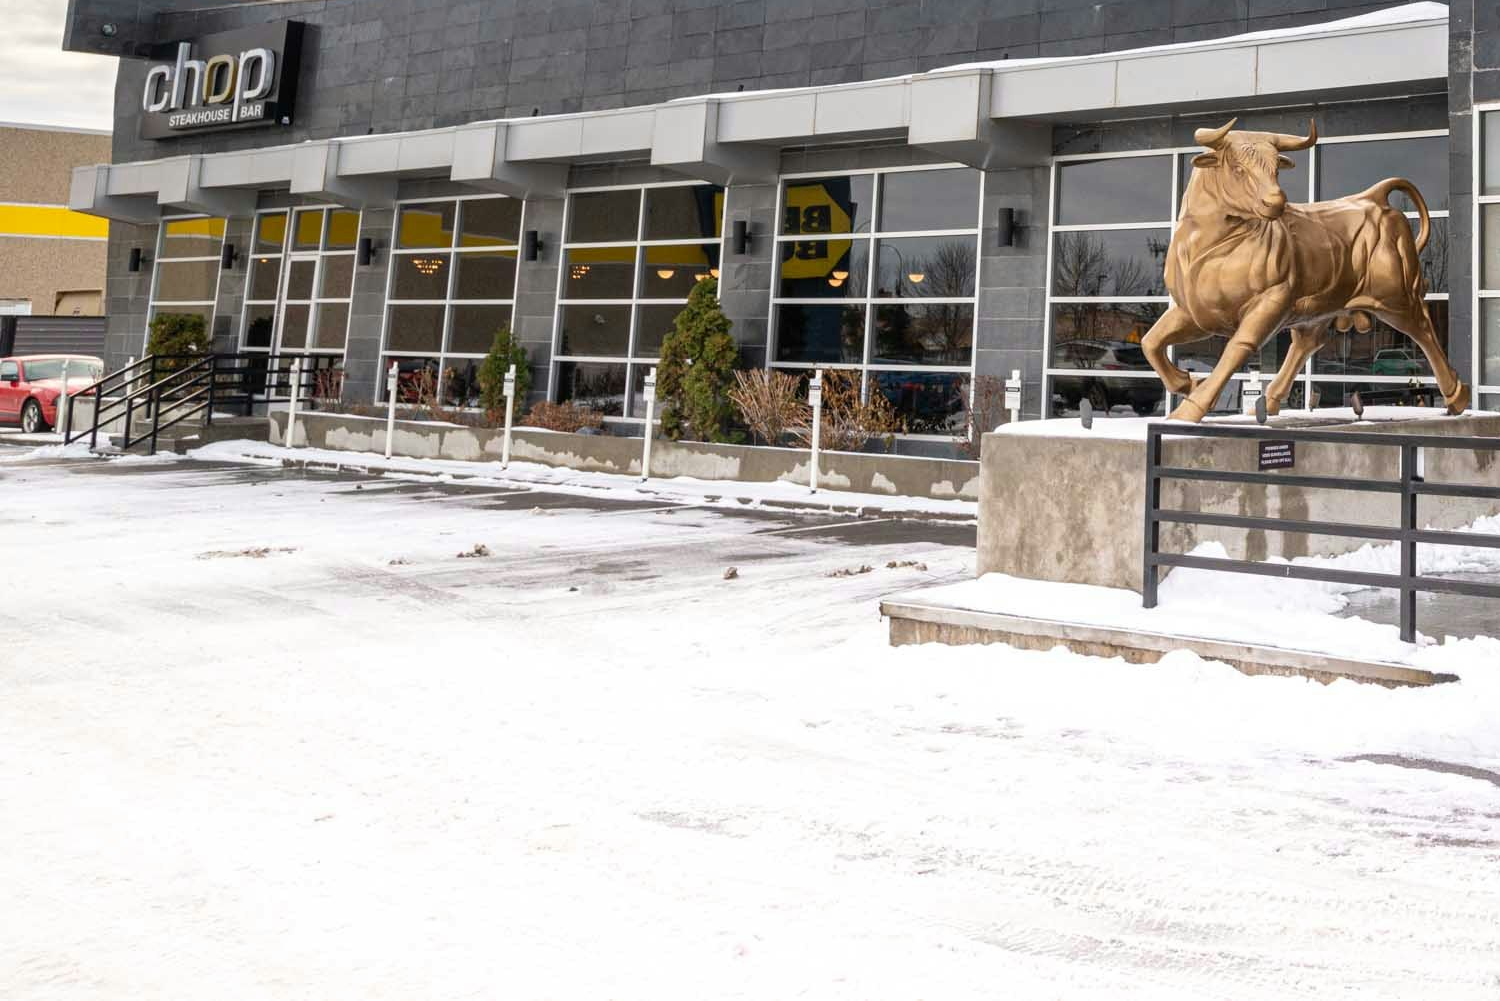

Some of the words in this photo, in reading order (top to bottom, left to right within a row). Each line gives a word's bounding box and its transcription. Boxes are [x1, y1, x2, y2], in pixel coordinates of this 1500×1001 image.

[143, 42, 274, 122] chop
[169, 108, 231, 127] STEAKHOUSE
[240, 104, 262, 118] BAR
